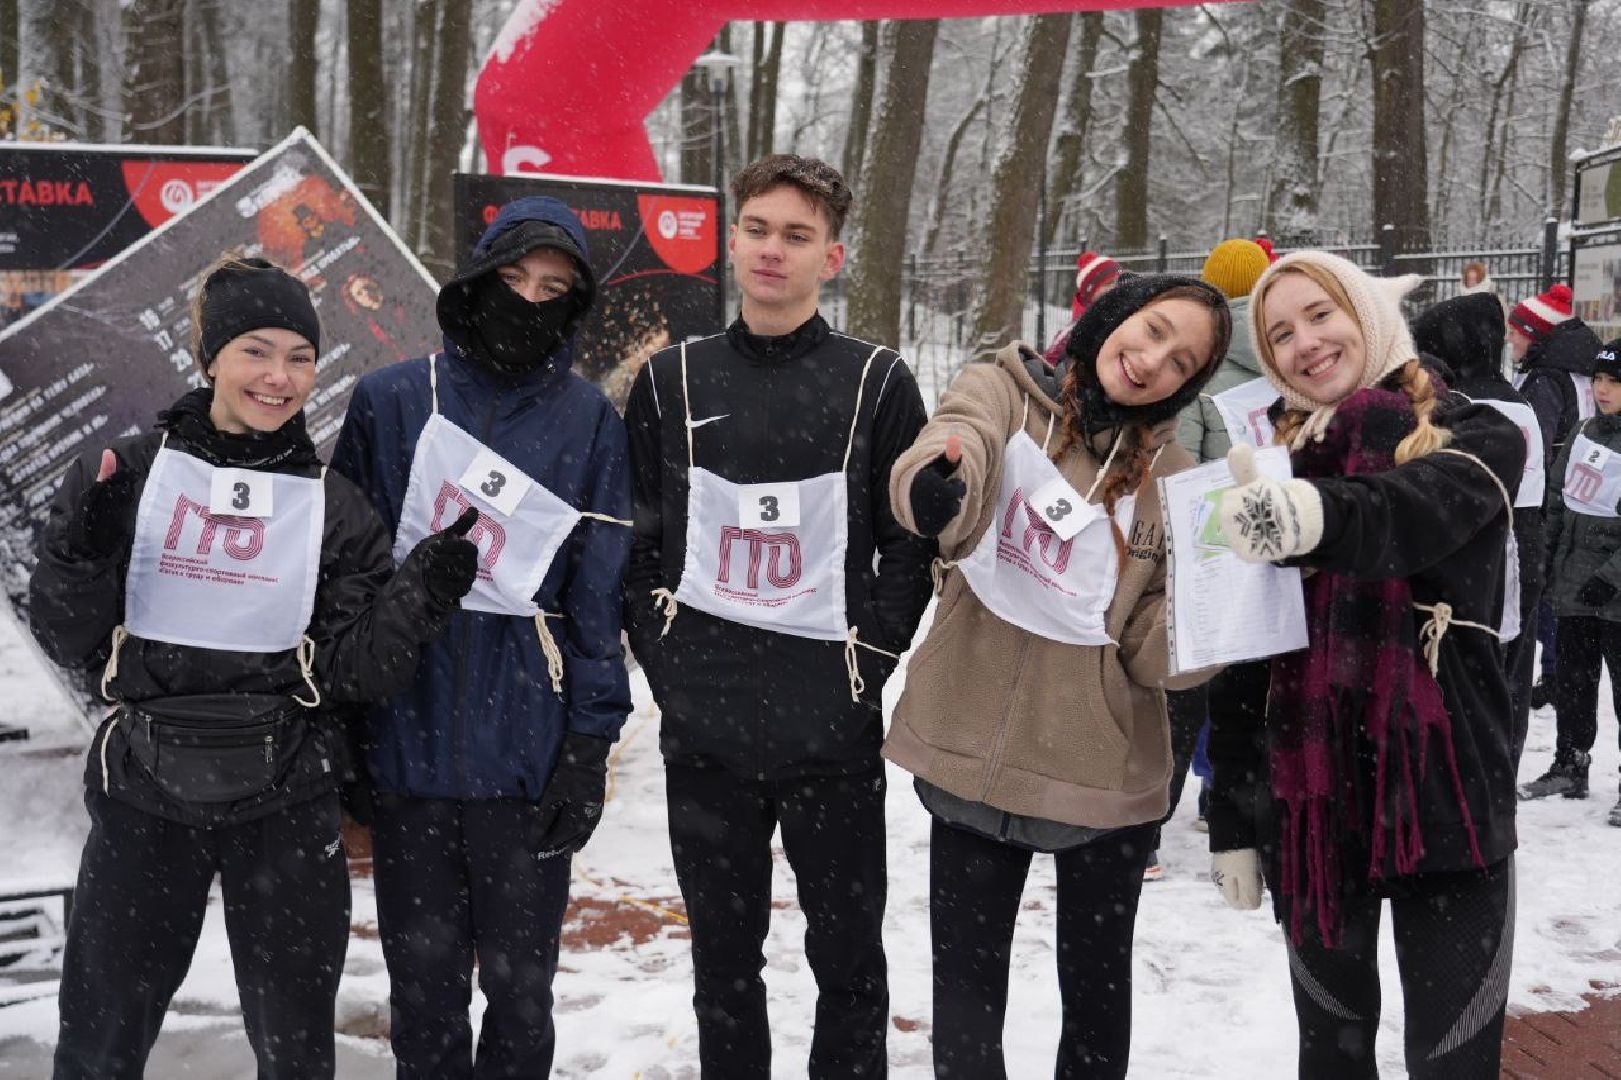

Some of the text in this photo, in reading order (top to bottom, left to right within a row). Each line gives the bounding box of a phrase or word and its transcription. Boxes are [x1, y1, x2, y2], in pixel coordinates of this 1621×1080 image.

[0, 180, 94, 206] ТАВКА
[232, 482, 250, 510] 3
[481, 470, 507, 497] 3
[759, 496, 779, 521] 3
[1046, 498, 1073, 521] 3
[164, 493, 265, 560] ГТО
[717, 525, 801, 588] ГТО
